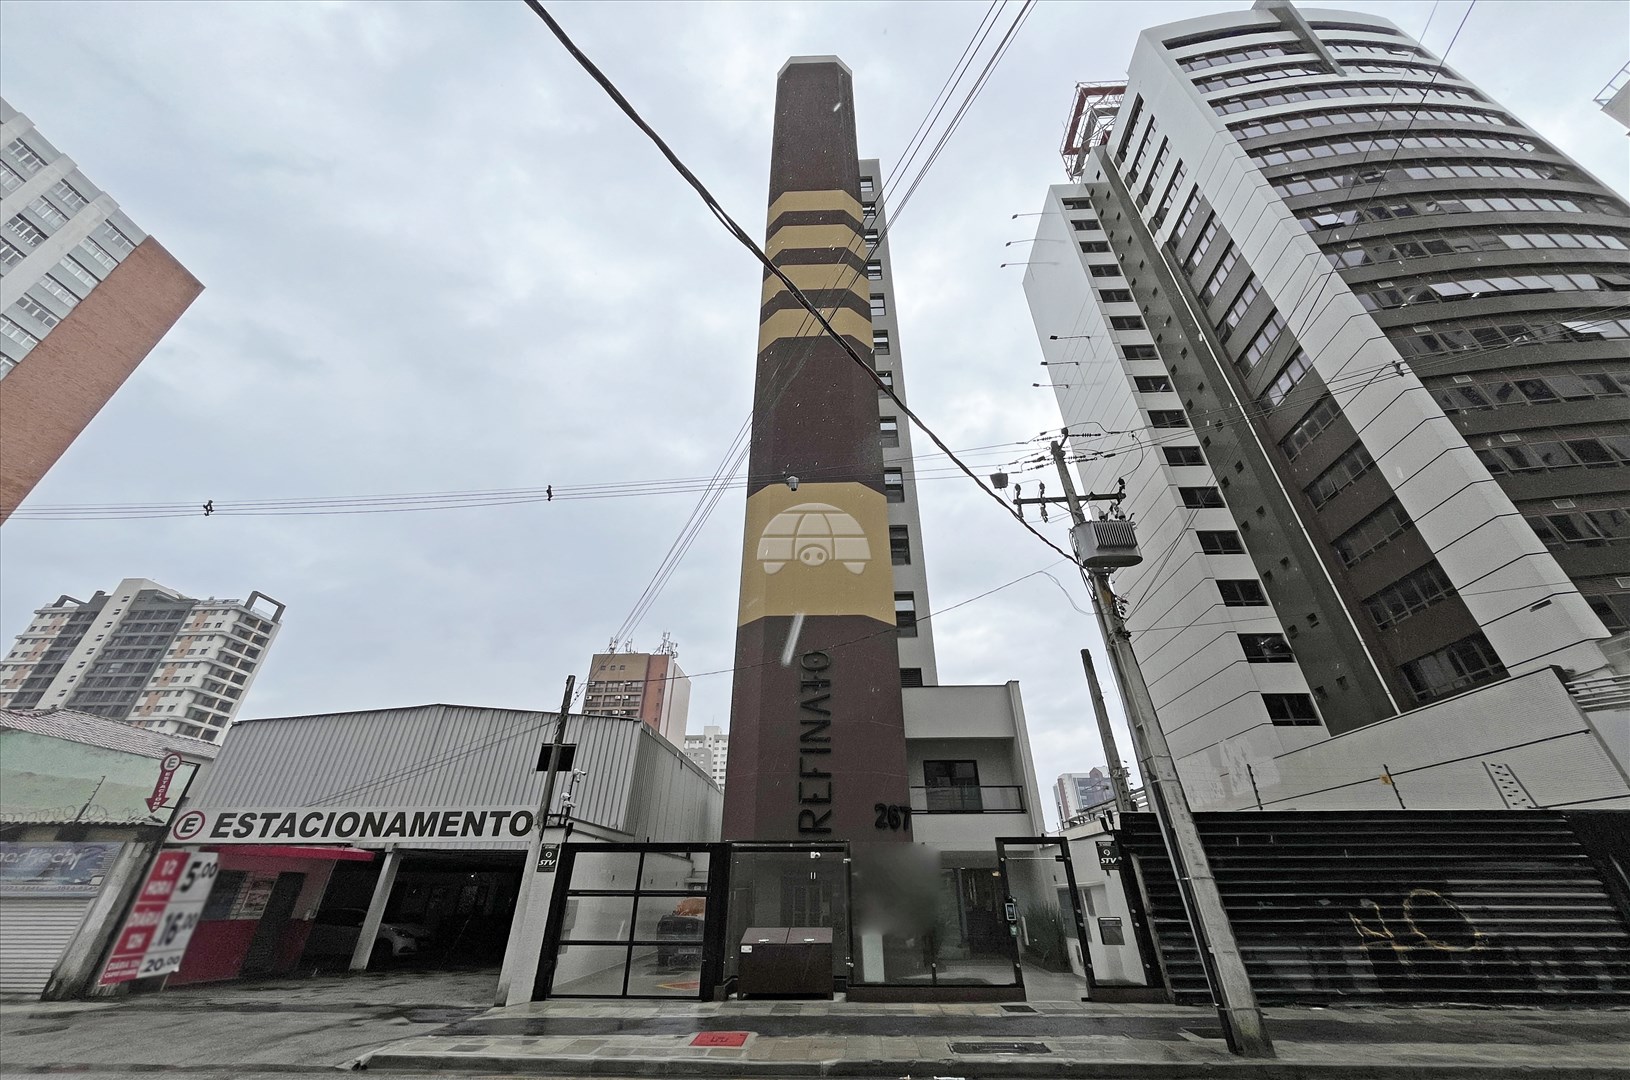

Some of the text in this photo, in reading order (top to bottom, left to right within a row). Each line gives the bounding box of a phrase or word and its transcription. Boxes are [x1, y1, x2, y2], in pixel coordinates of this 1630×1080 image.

[798, 649, 832, 834] REFINATO
[166, 757, 177, 769] E
[151, 771, 171, 810] ESTACIONE
[180, 810, 535, 839] E ESTACIONAMENTO
[874, 803, 912, 832] 267
